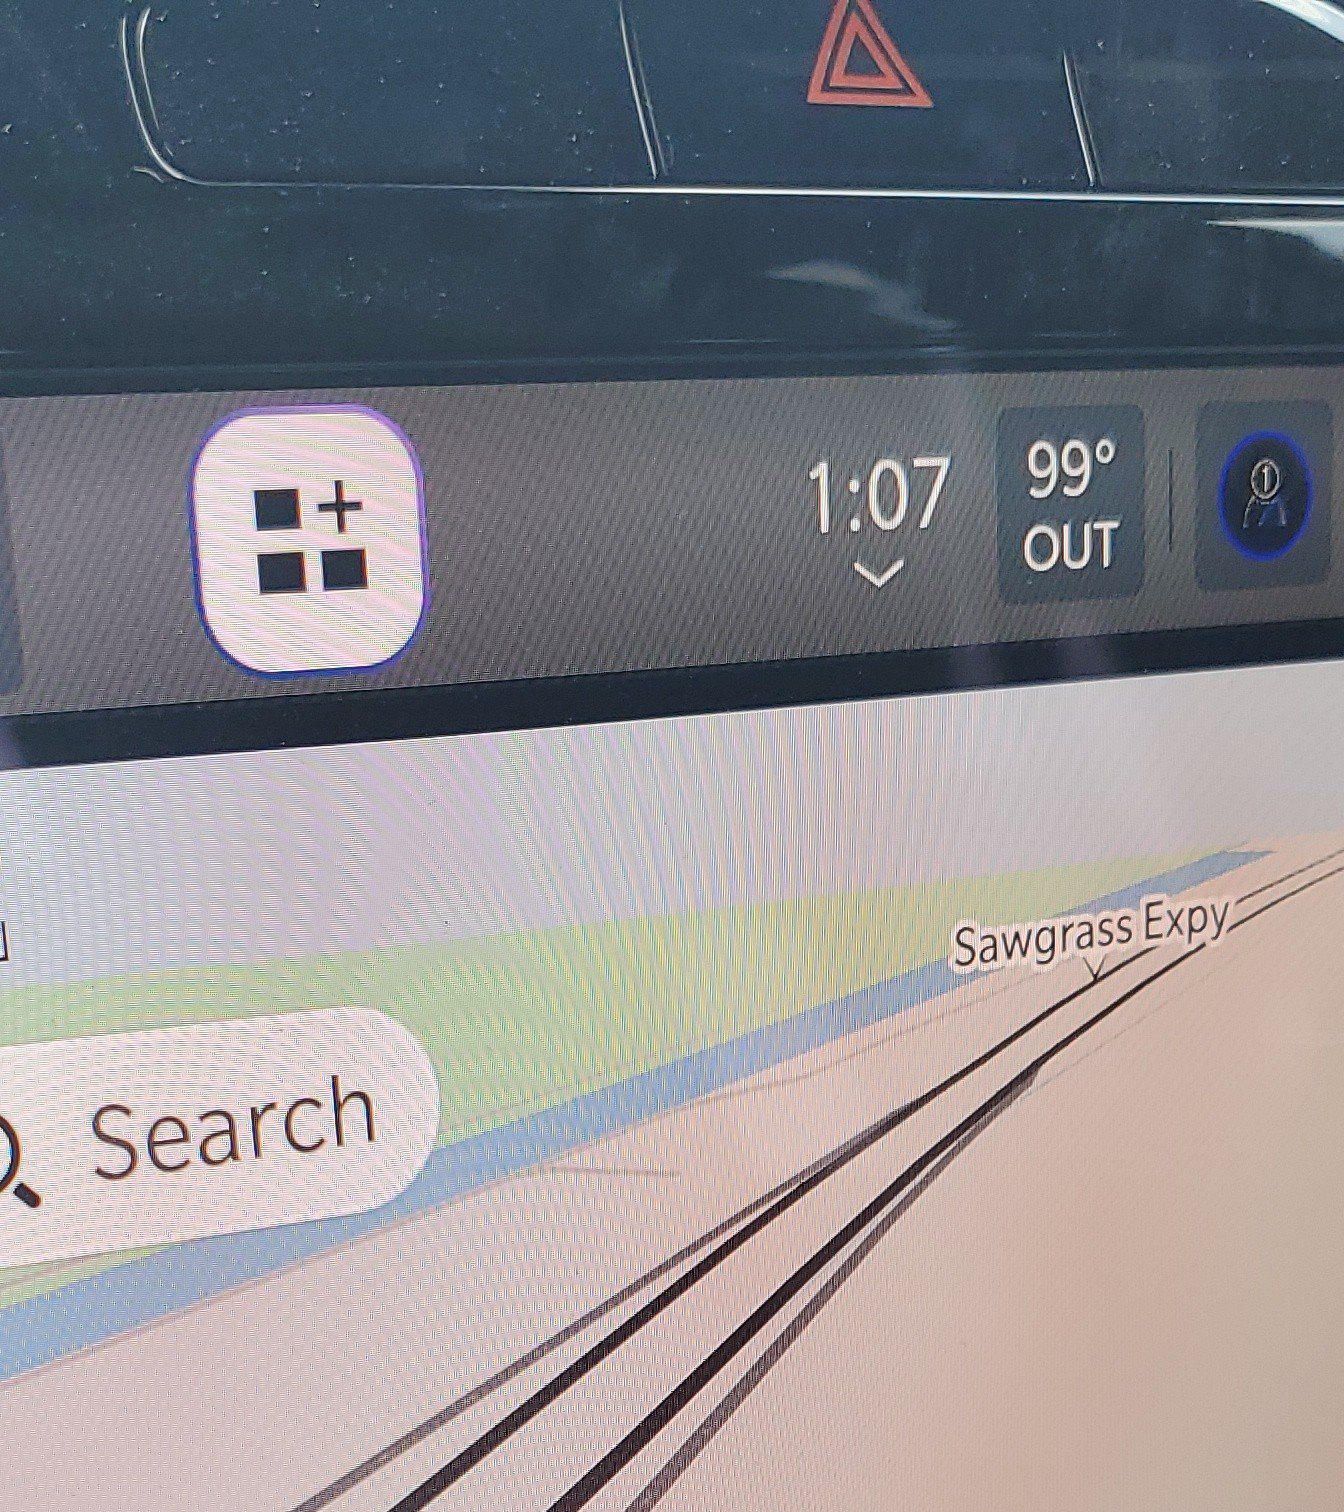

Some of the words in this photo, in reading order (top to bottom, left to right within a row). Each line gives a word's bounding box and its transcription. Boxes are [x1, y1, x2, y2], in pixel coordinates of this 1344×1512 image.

[809, 456, 950, 534] 1:07
[1027, 438, 1117, 498] 99°
[1023, 521, 1122, 572] OUT
[955, 913, 1133, 967] Sawgrass
[1144, 900, 1229, 942] Expy
[92, 1075, 377, 1180] Search
